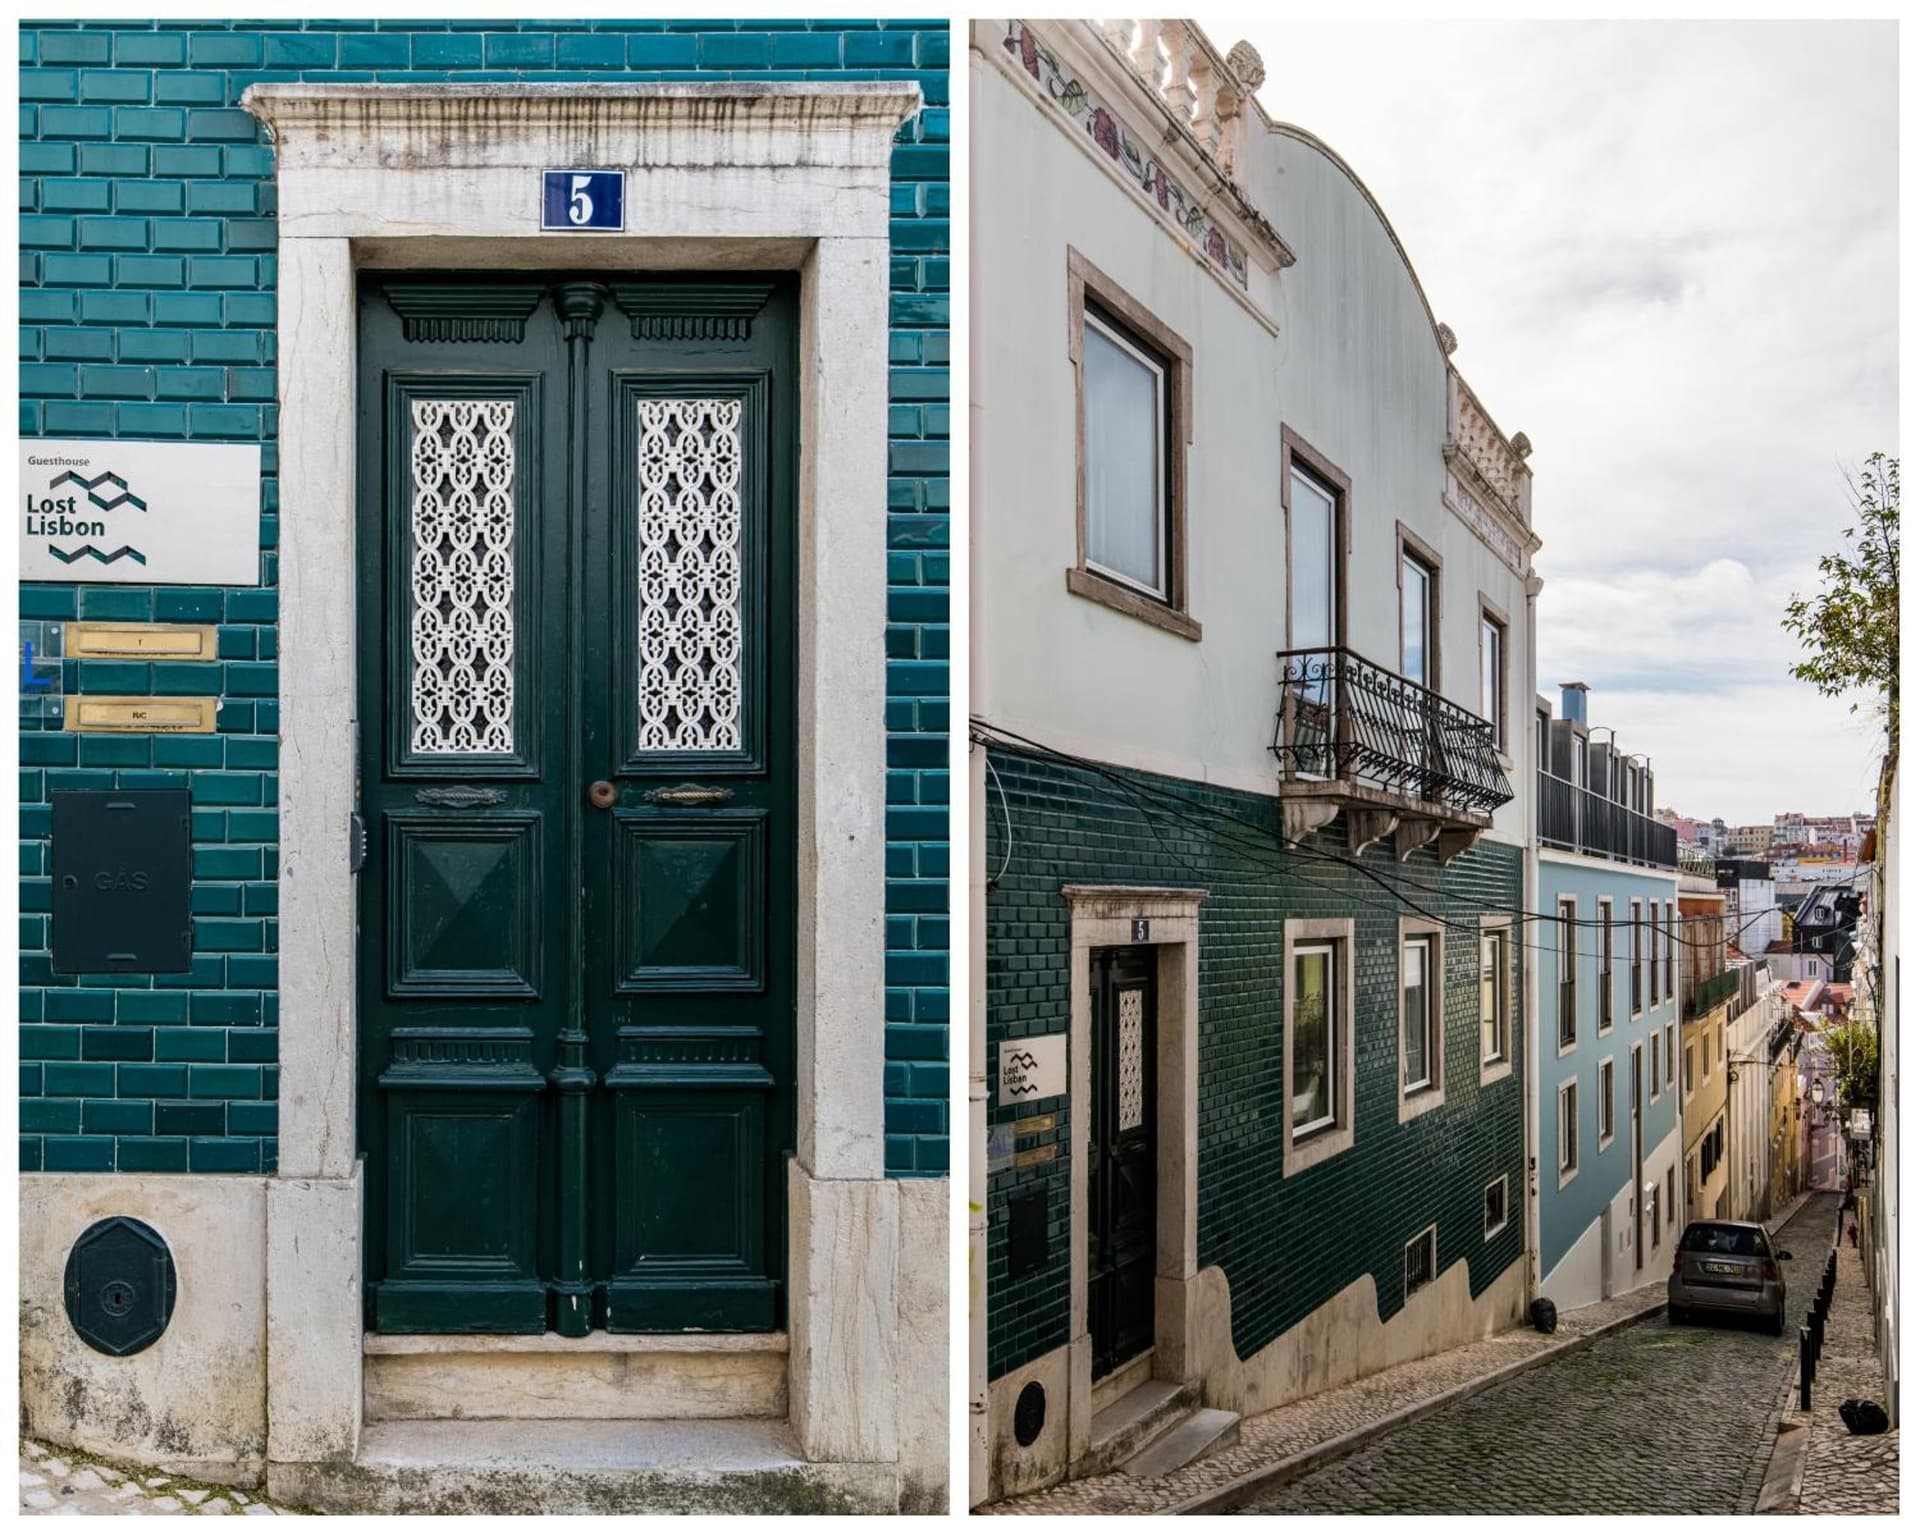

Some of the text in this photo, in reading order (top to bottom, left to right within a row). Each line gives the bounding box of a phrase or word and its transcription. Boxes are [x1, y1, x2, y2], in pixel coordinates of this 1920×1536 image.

[569, 175, 594, 225] 5
[28, 455, 90, 466] Guesthouse
[27, 494, 77, 514] Lost
[27, 515, 105, 536] Lisbon
[1138, 920, 1145, 940] 5
